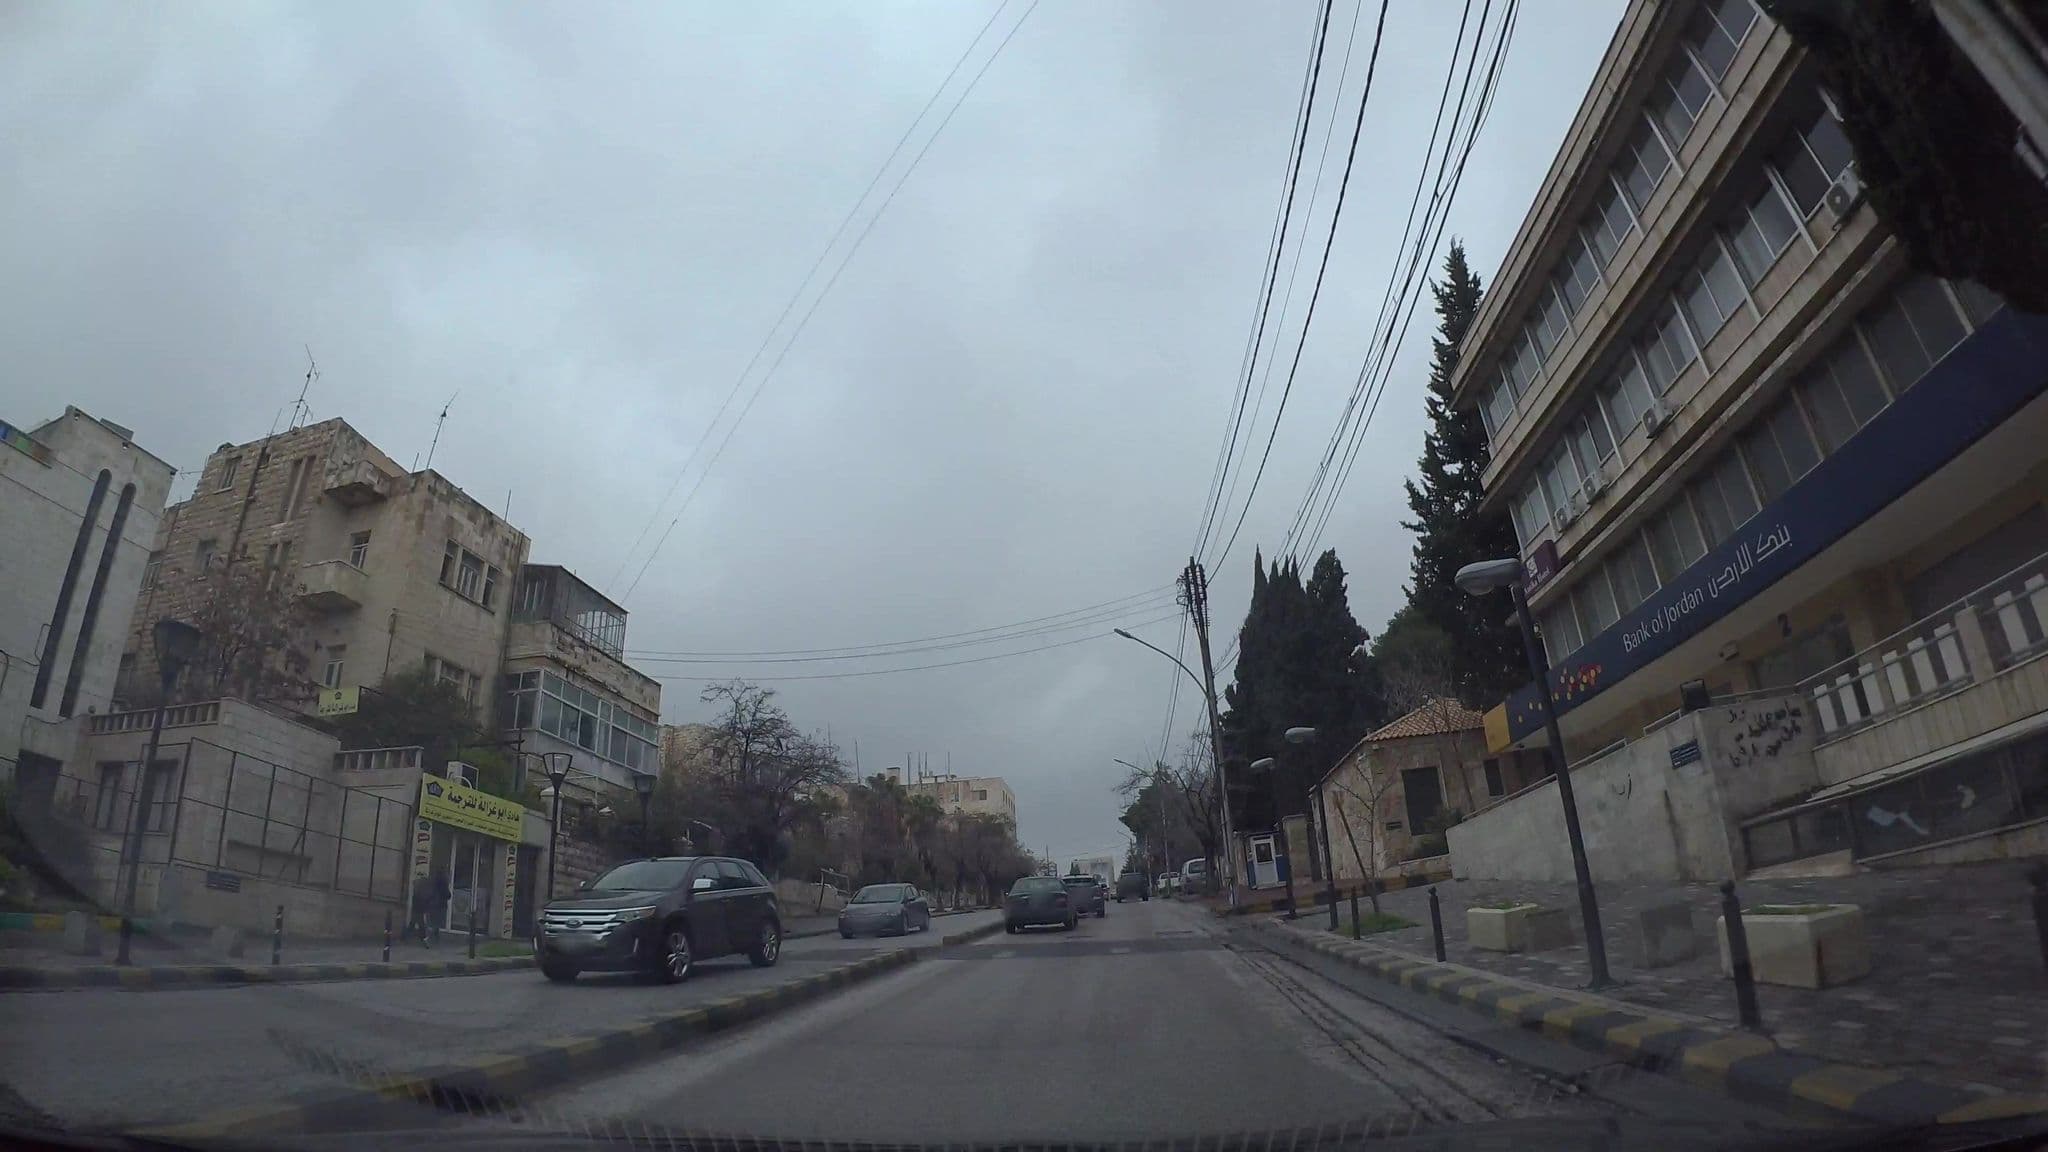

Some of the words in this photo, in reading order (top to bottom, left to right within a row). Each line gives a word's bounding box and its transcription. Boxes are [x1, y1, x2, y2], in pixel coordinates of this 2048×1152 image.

[1755, 524, 1794, 564] بنك
[1622, 619, 1652, 653] Bank
[1650, 612, 1664, 634] of
[1663, 587, 1705, 632] Jordan
